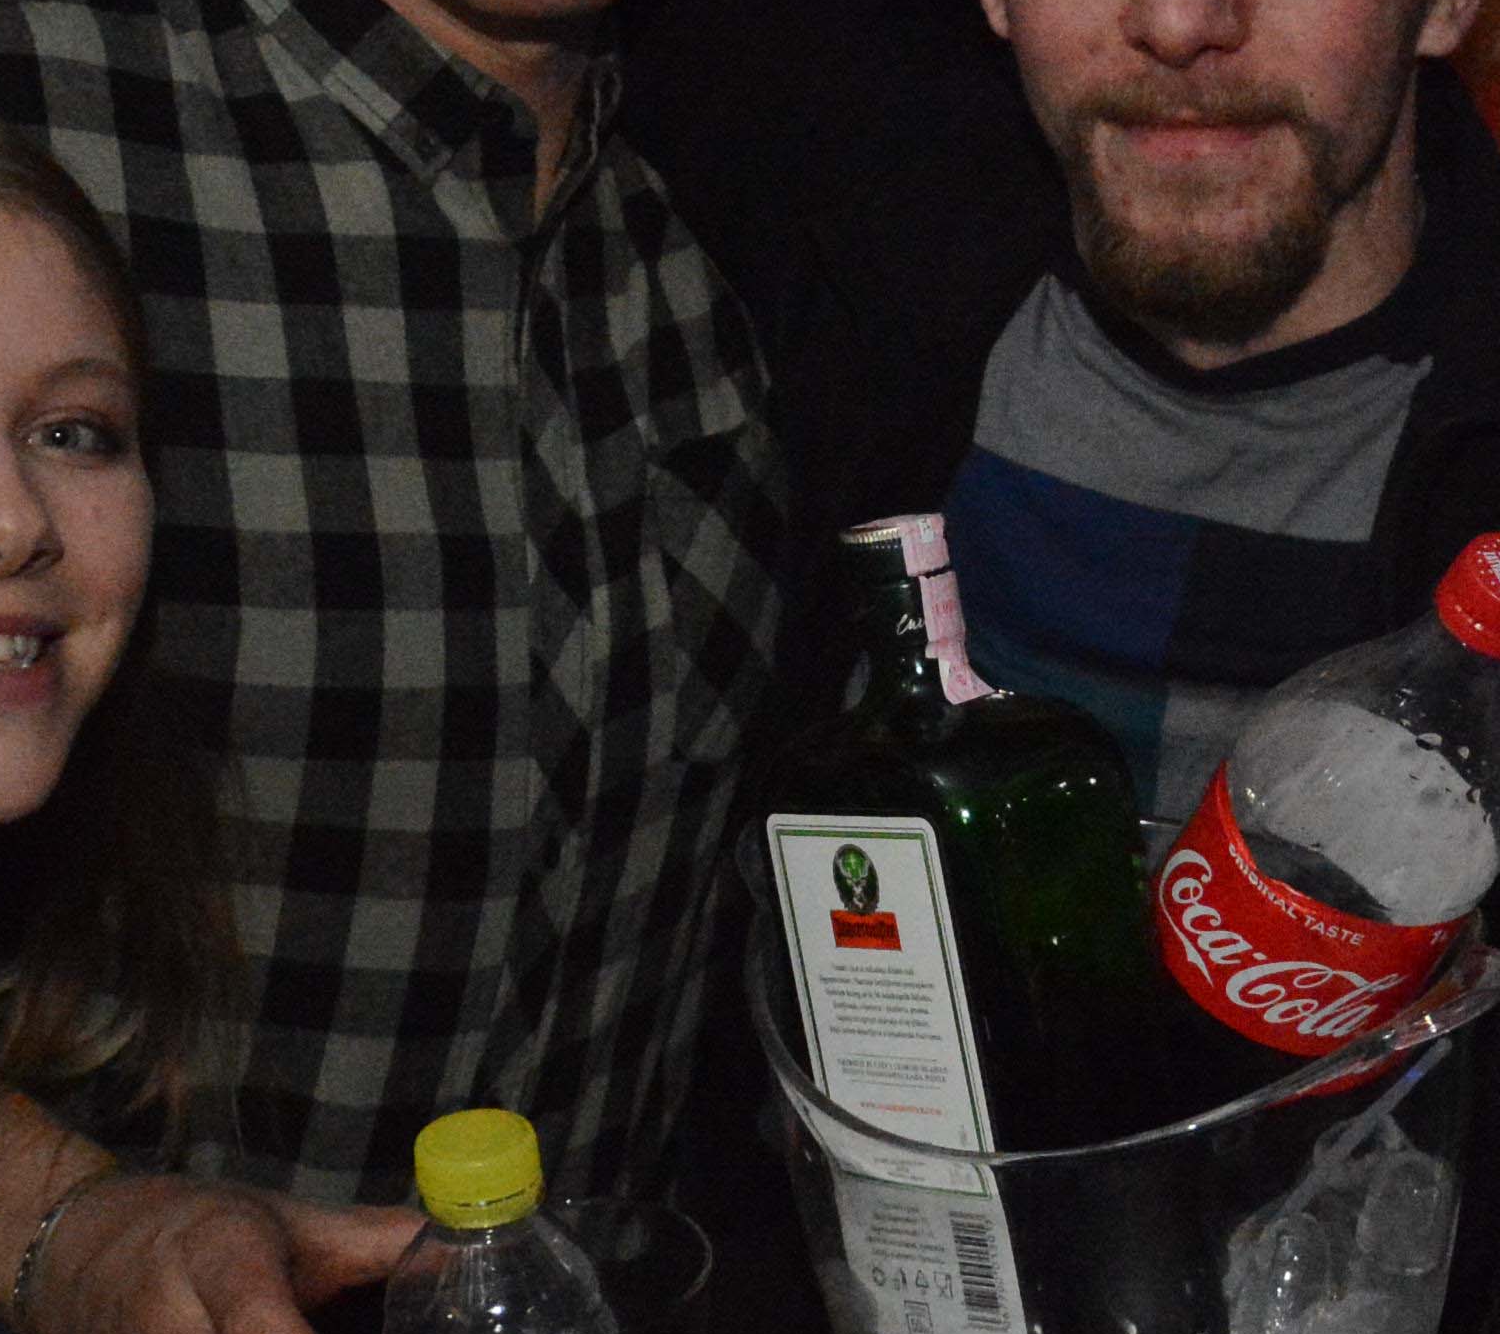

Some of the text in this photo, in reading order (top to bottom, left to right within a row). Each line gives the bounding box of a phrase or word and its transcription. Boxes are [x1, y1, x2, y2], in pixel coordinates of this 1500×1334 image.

[1158, 848, 1407, 1038] Coca-Cola
[1228, 842, 1366, 947] ORIGINAL TASTE
